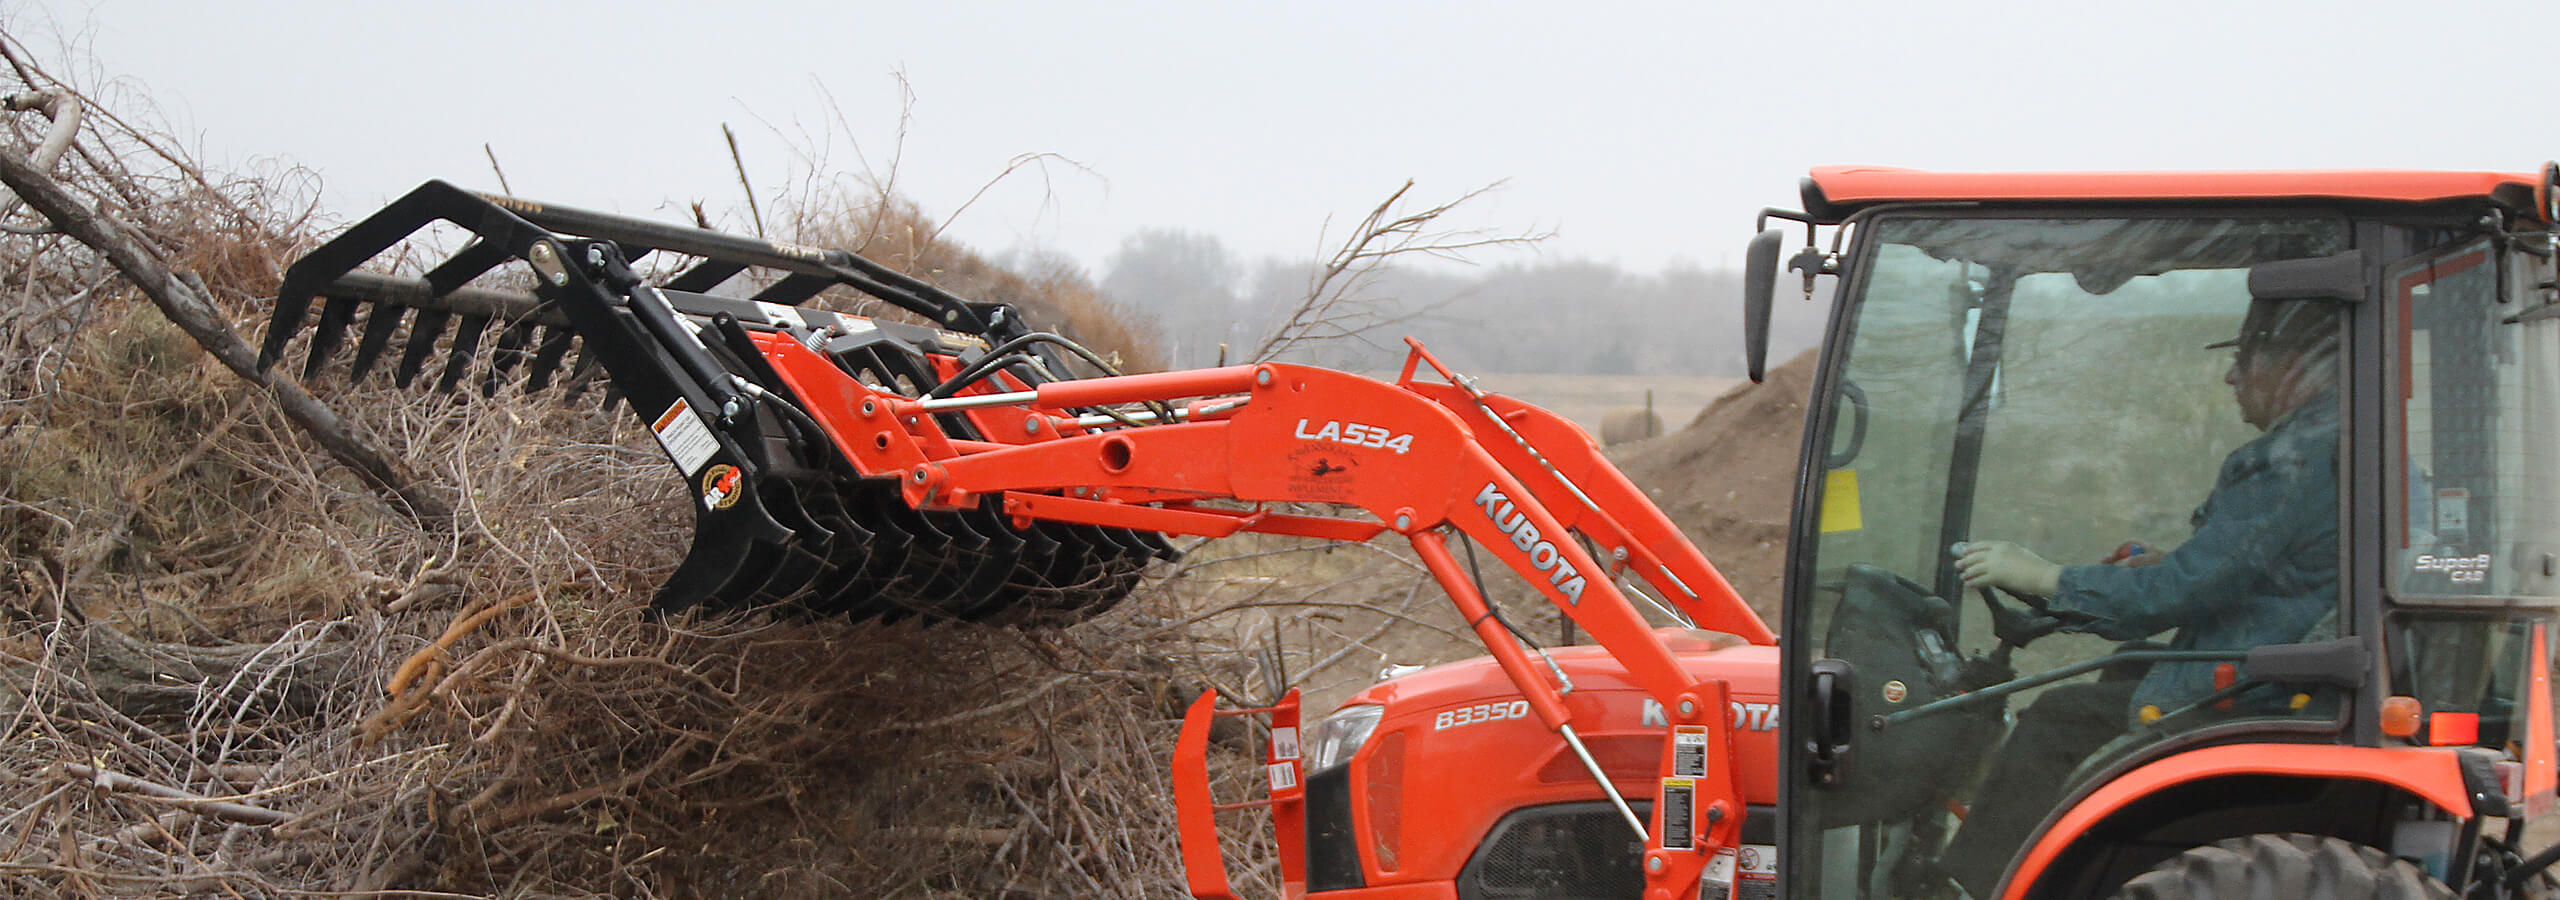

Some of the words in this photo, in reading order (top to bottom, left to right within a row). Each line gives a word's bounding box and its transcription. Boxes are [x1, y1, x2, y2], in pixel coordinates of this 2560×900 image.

[1295, 418, 1414, 454] LA534
[1474, 481, 1586, 606] KUBOTA
[1435, 700, 1530, 730] B3350
[1642, 698, 1780, 731] KOTA
